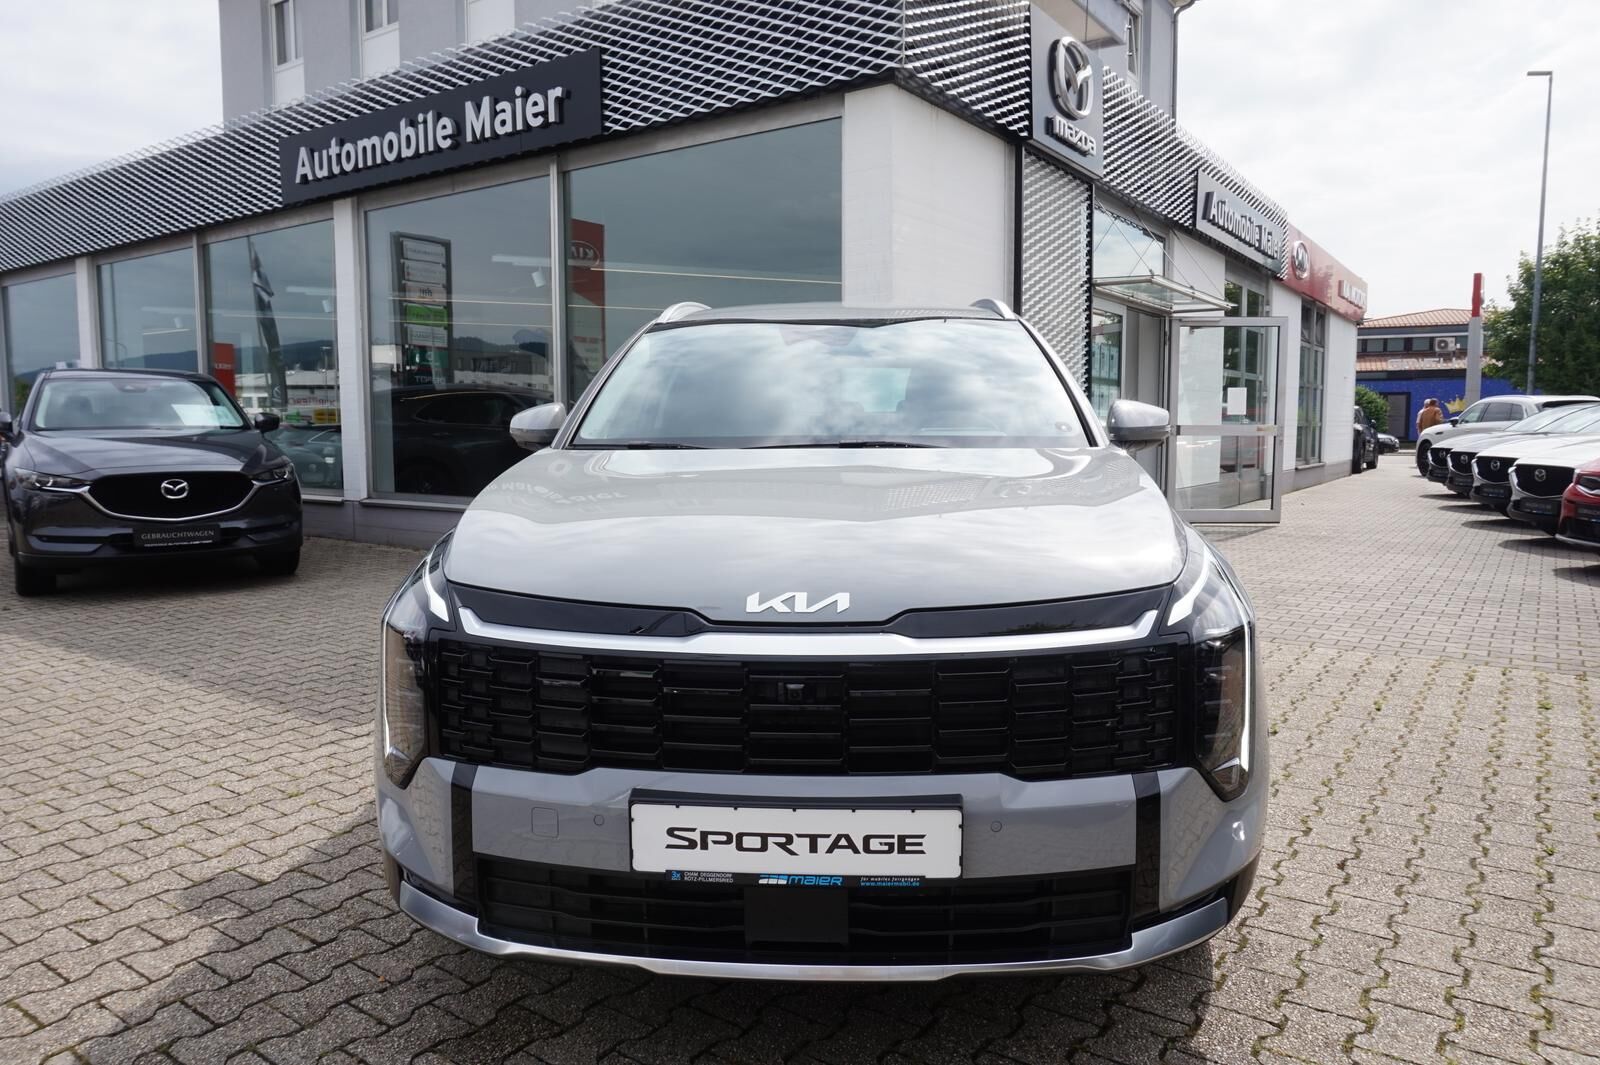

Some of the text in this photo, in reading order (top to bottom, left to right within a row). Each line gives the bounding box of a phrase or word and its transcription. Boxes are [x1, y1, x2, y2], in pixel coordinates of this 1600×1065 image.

[295, 86, 565, 184] Automobile Maier
[1051, 115, 1097, 157] mazda
[1204, 191, 1260, 248] Automobile
[141, 530, 215, 540] GEBRAUCHTWAGEN
[746, 591, 850, 614] KIA
[665, 826, 927, 857] SPORTAGE
